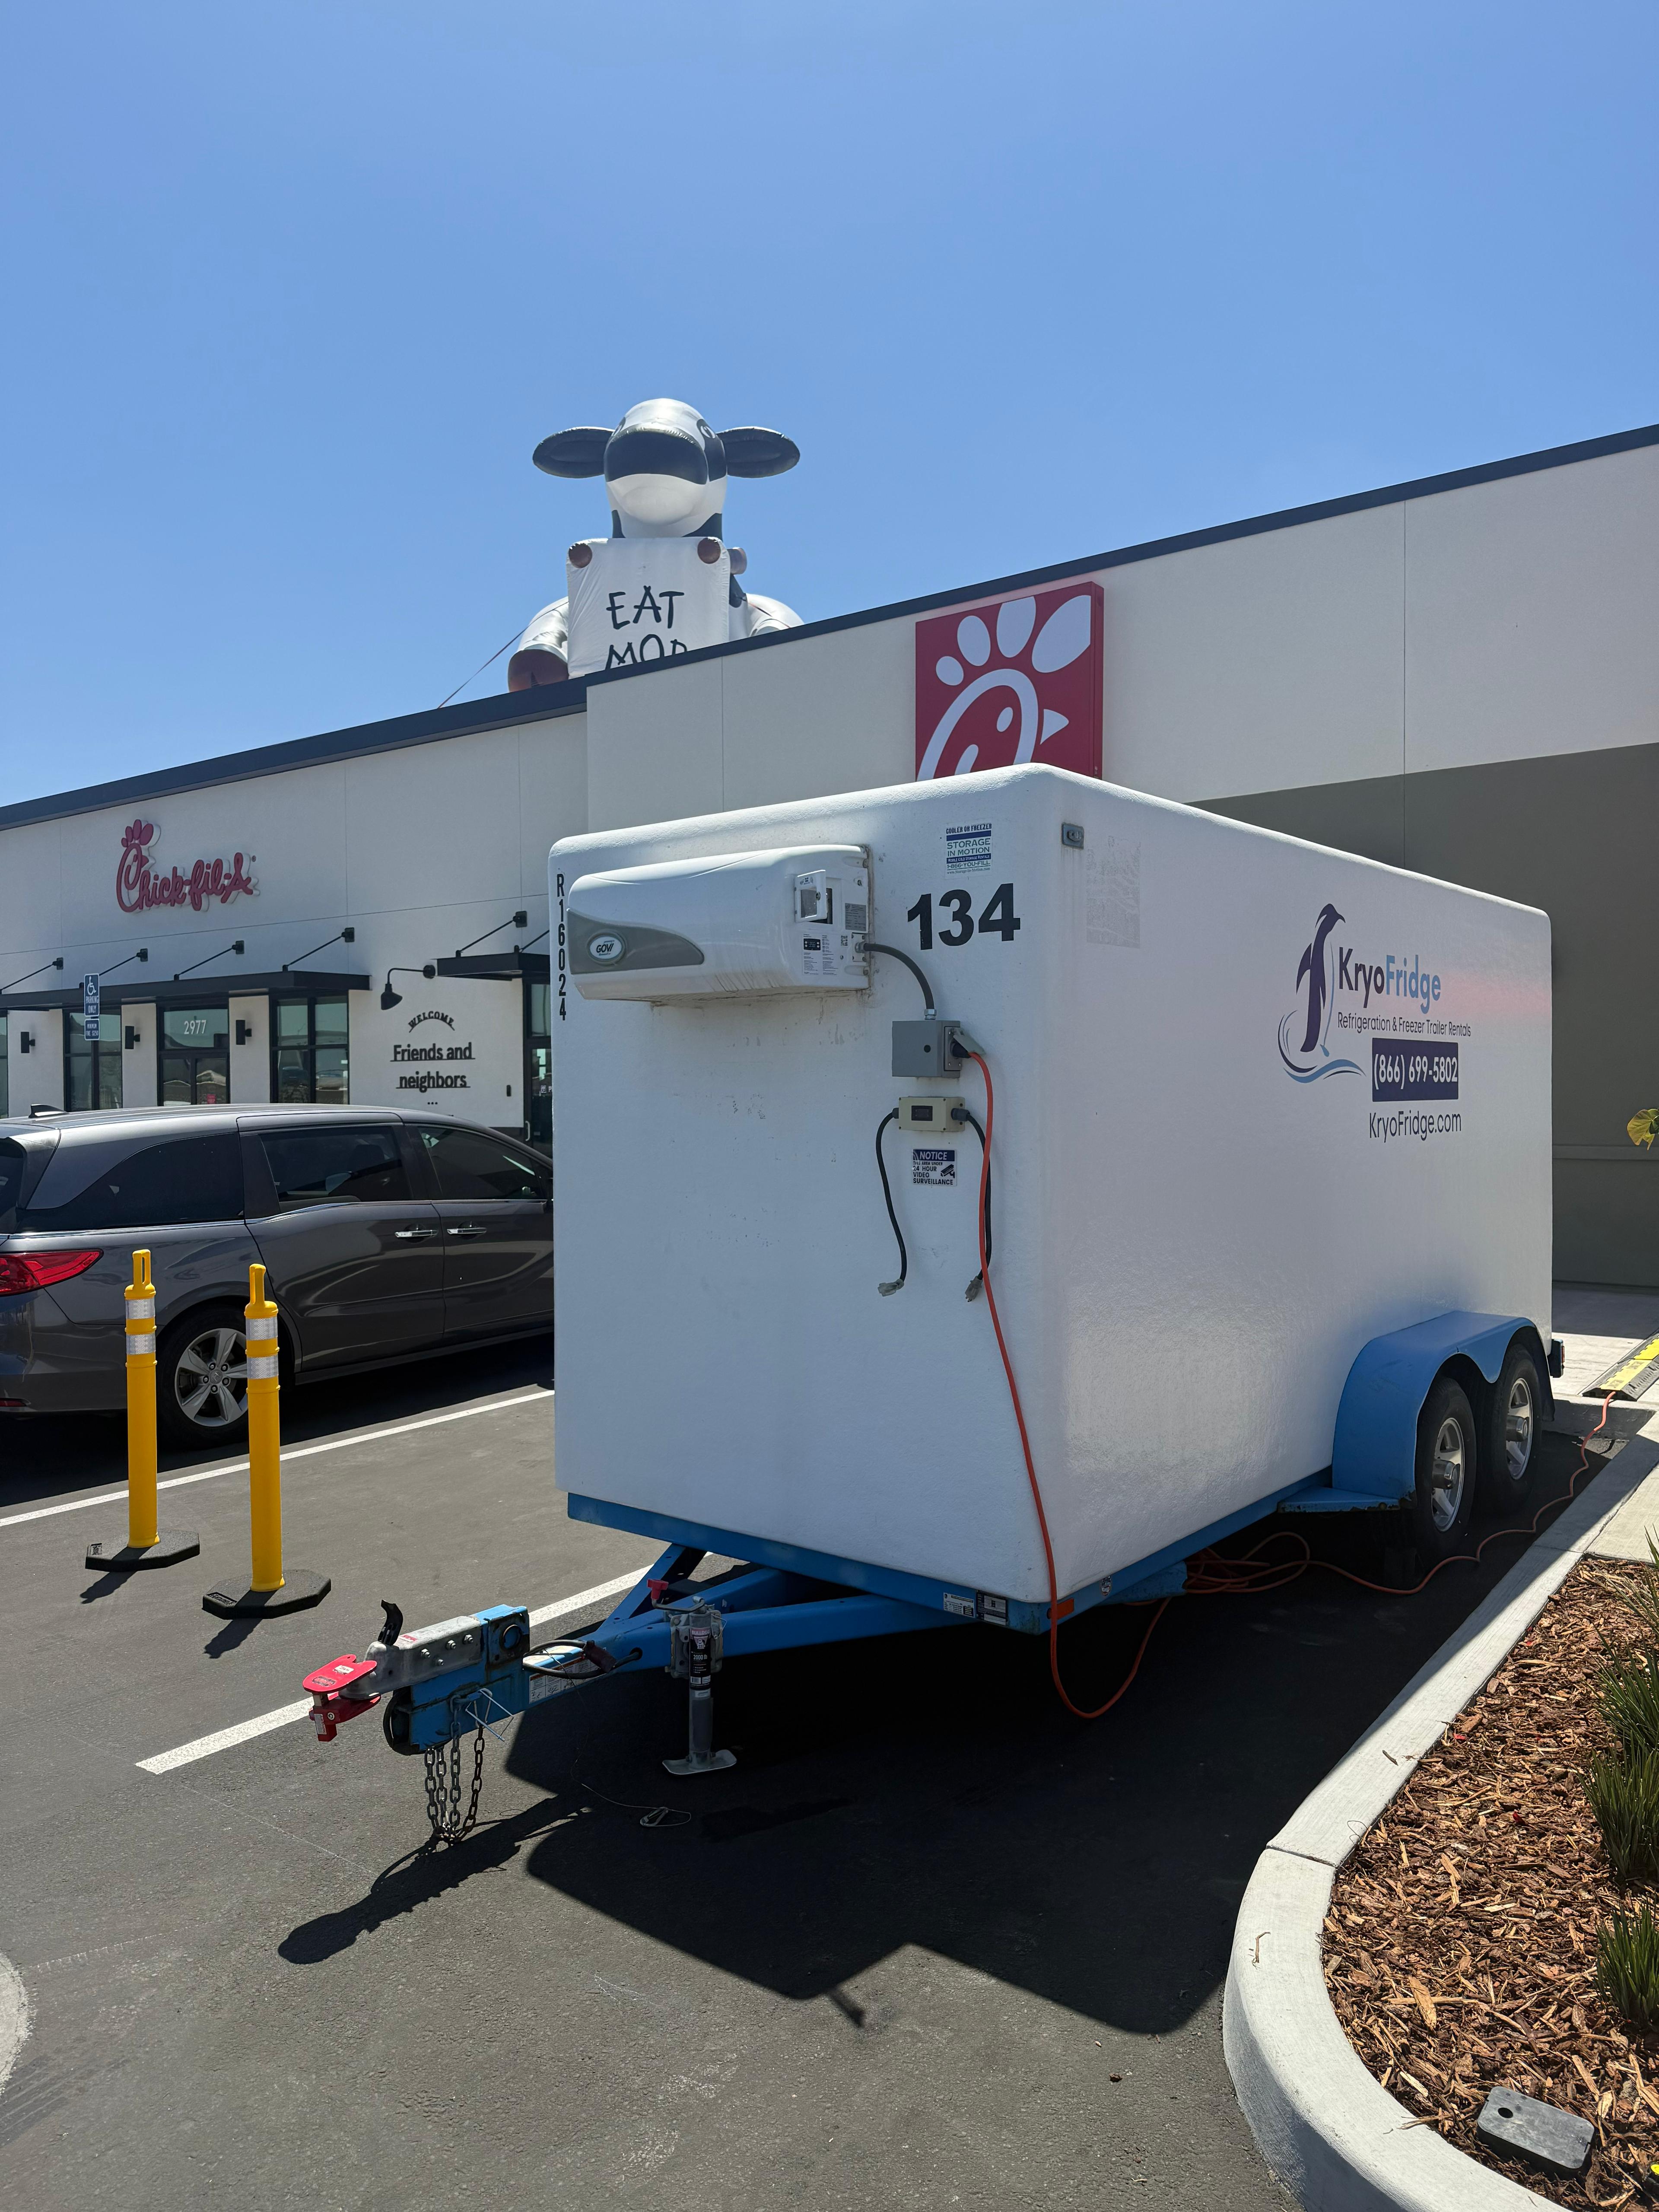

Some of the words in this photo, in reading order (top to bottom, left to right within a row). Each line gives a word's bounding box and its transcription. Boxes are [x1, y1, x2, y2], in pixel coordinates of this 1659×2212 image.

[606, 585, 684, 629] EAT
[971, 823, 992, 831] FREEZER
[947, 838, 991, 849] STORAGE
[958, 846, 989, 856] MOTION
[116, 838, 254, 913] Chick-fil-A
[947, 860, 990, 869] 1-866-YOU-FILL
[907, 883, 1020, 950] 134
[556, 874, 567, 1021] R16024
[1339, 947, 1441, 1014] KryoFridge
[184, 1020, 207, 1035] 2977
[408, 1011, 454, 1029] WELCOME
[1338, 1011, 1390, 1034] Refrigeration
[1392, 1016, 1398, 1032] &
[1399, 1017, 1425, 1033] Freezer
[1426, 1019, 1447, 1035] Trailer
[1449, 1021, 1471, 1037] Rentals
[394, 1043, 443, 1061] Friends
[446, 1042, 472, 1060] and
[399, 1071, 467, 1093] neighbors
[1374, 1053, 1405, 1090] (866)
[1408, 1055, 1458, 1083] 699-5802
[1370, 1109, 1462, 1143] KryoFridge.com
[919, 1151, 947, 1160] NOTICE
